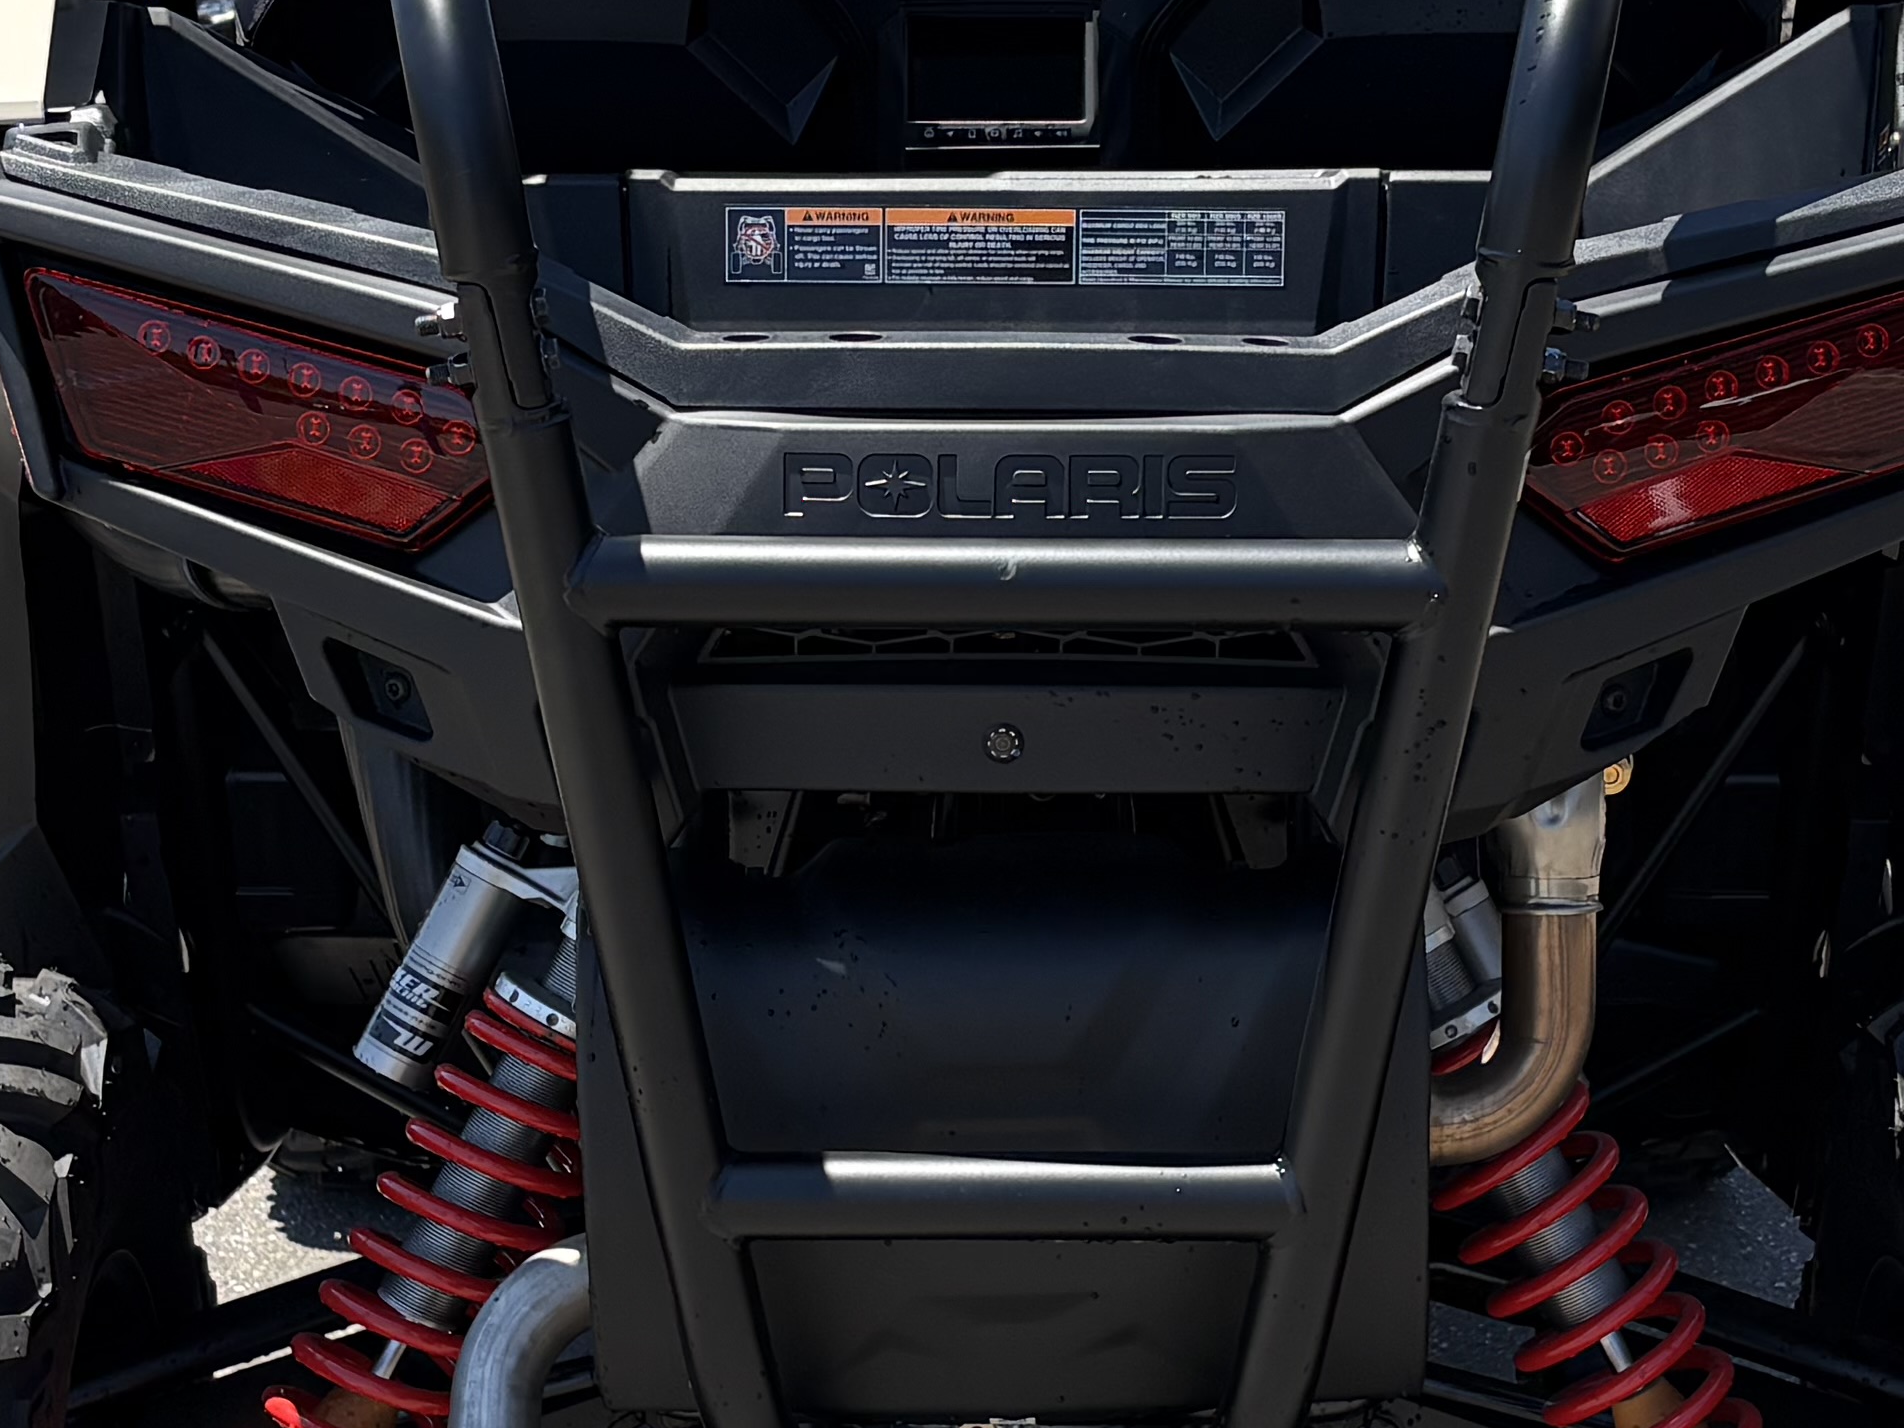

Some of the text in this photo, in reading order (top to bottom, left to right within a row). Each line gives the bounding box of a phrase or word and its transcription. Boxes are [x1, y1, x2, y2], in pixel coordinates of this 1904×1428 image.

[815, 212, 869, 222] WARNING
[959, 213, 1015, 223] WARNING
[783, 452, 1239, 520] POLARIS
